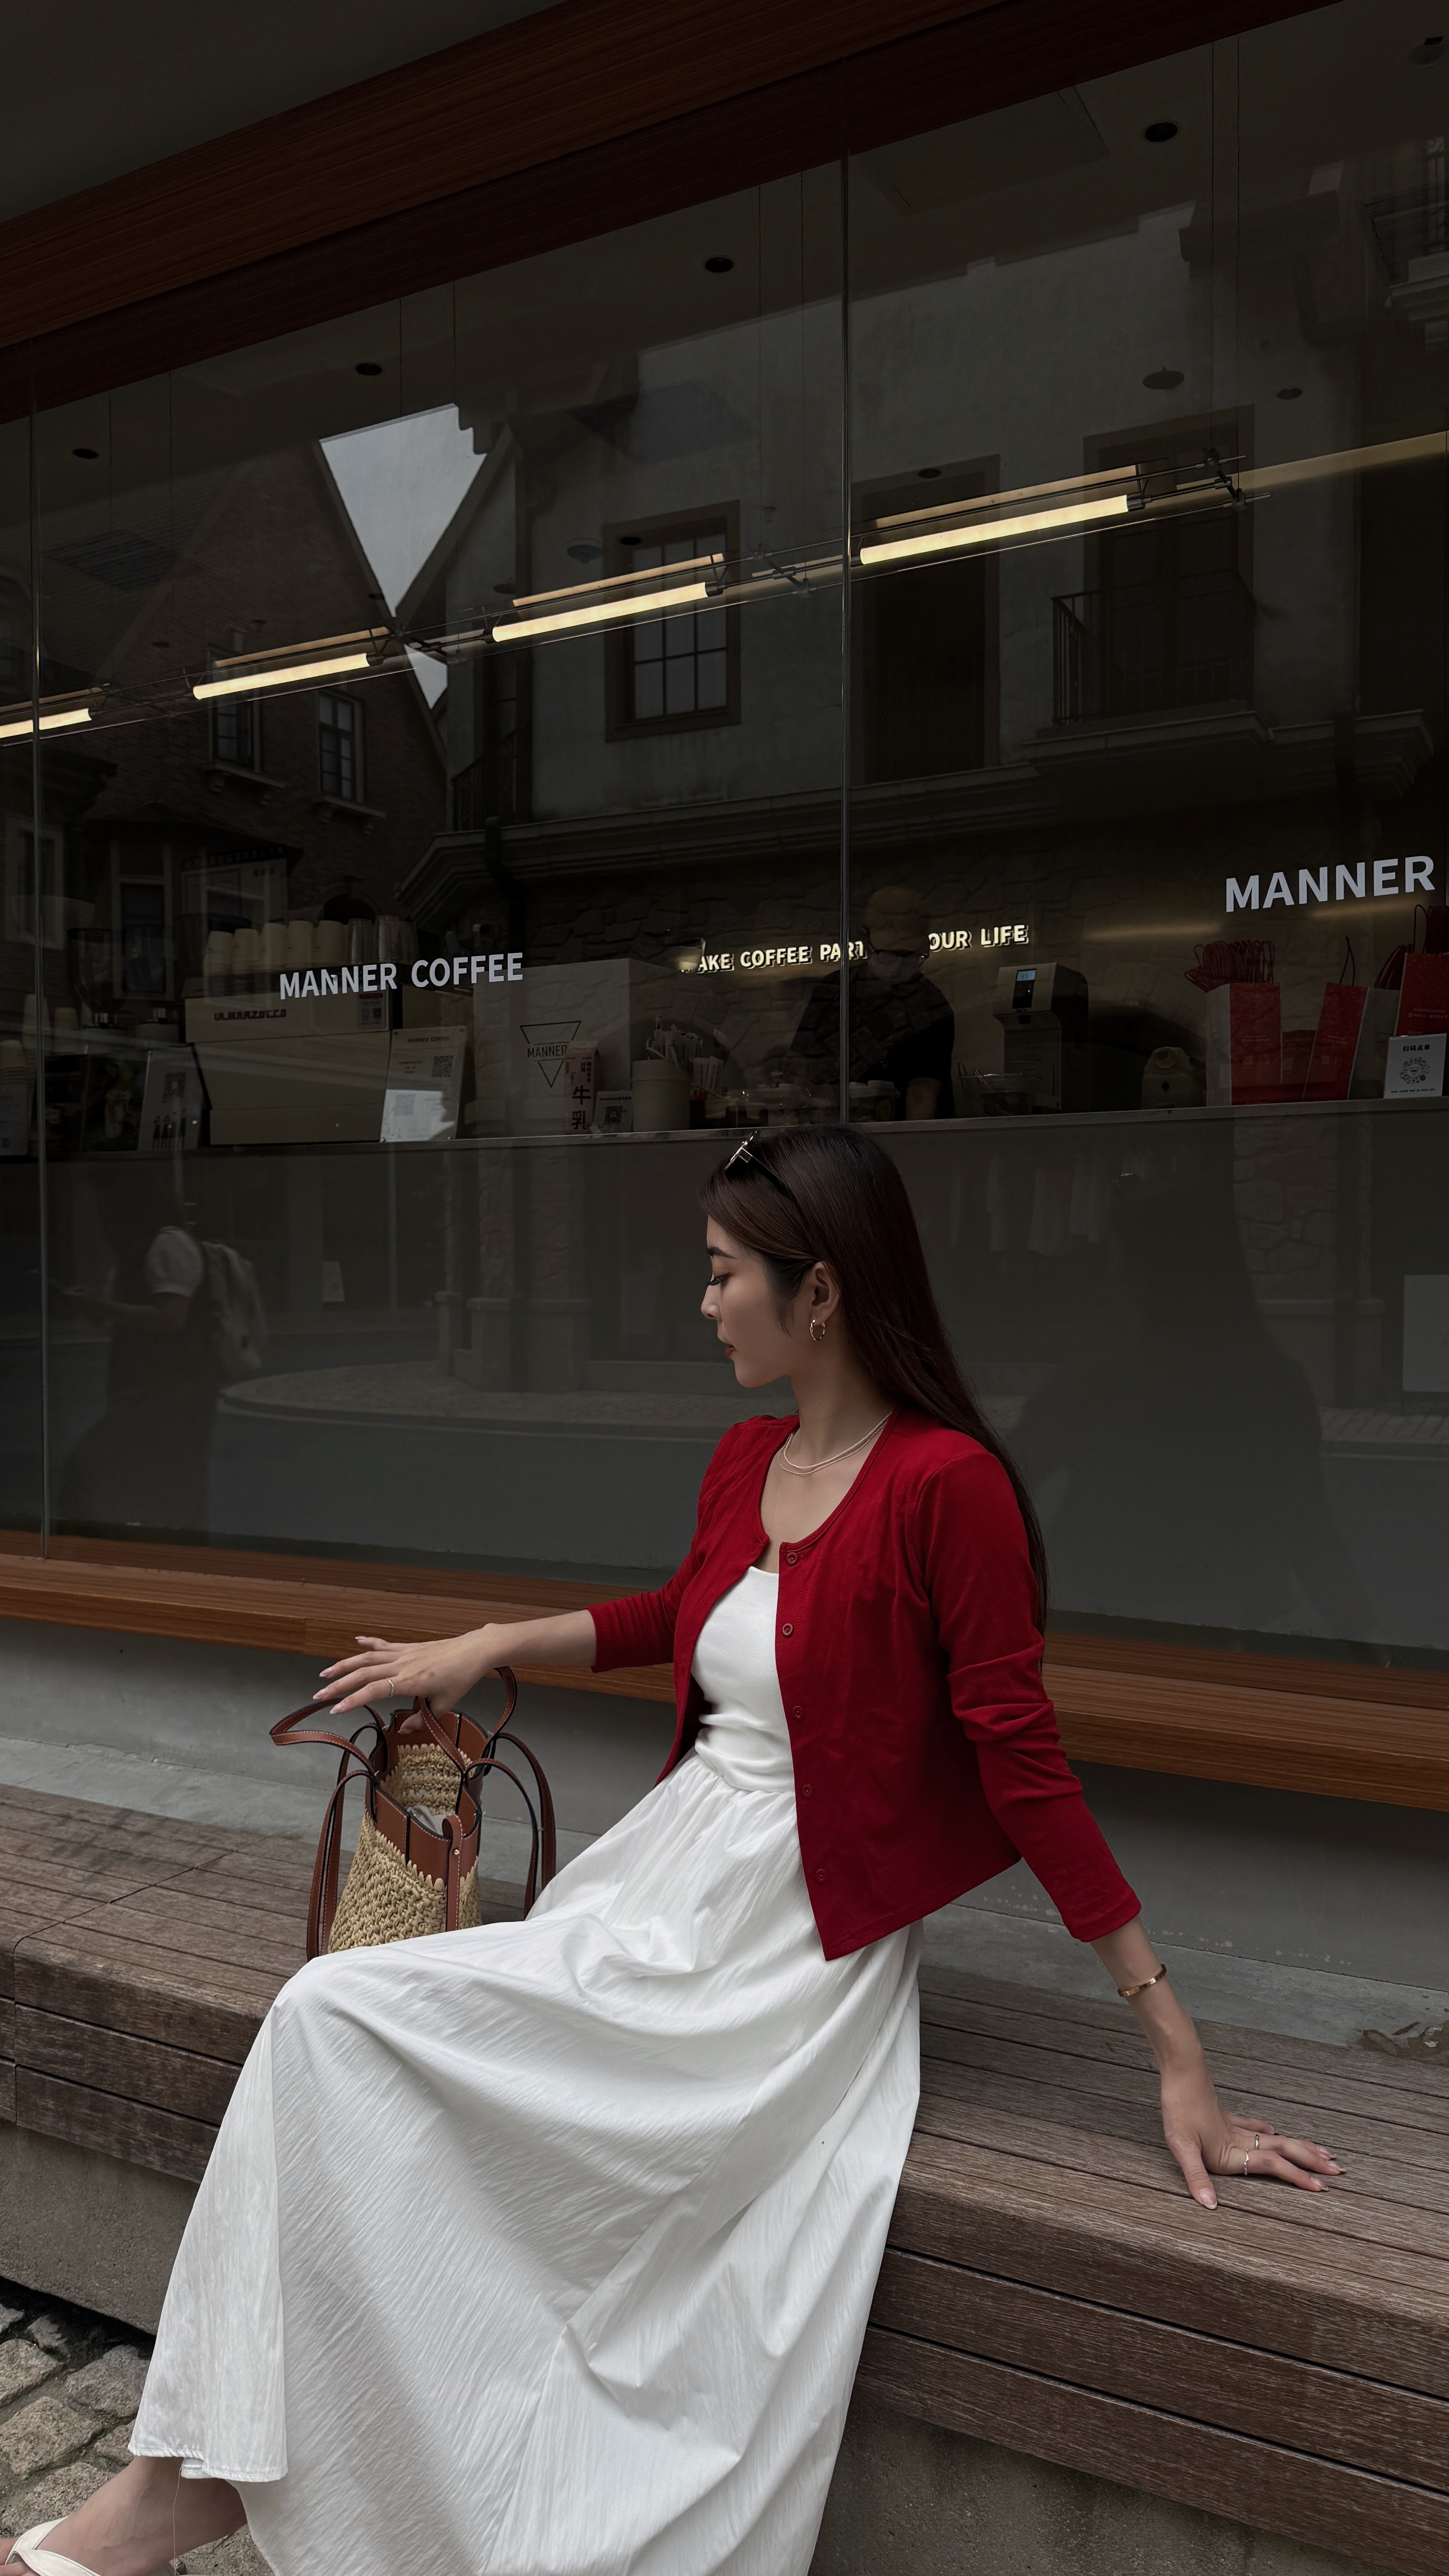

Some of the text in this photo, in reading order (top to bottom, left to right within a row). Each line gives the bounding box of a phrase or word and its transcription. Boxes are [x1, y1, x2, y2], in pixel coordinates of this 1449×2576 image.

[1225, 855, 1436, 913] MANNER
[685, 953, 733, 972] AKE
[740, 946, 810, 967] COFFEE
[928, 930, 969, 951] OUR
[980, 925, 1027, 946] LIFE
[280, 952, 524, 1000] MANNER COFFEE
[527, 1045, 567, 1058] MANNER
[1403, 1044, 1430, 1052] 扫码点单
[571, 1086, 591, 1130] 牛乳
